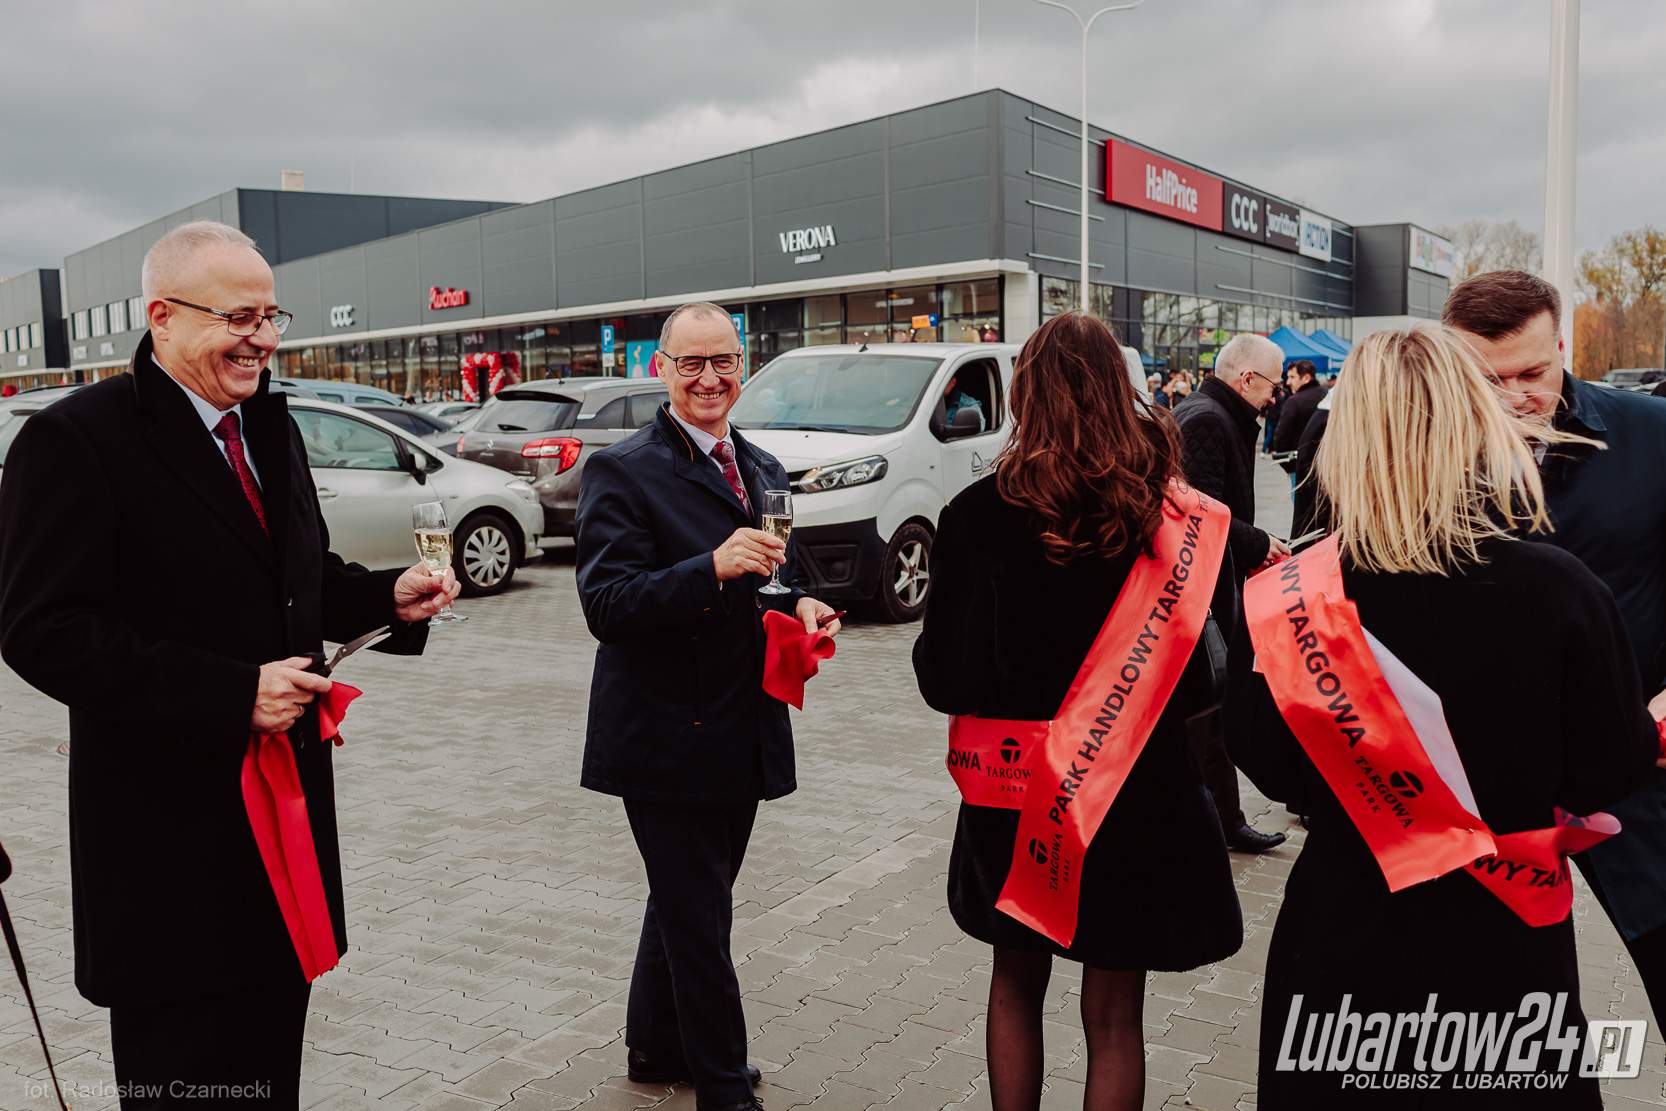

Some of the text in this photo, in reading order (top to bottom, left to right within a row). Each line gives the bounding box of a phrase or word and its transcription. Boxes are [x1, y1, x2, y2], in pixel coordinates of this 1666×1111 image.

[1145, 163, 1198, 214] HalfPrice
[1231, 192, 1258, 234] CCC
[779, 224, 836, 253] VERONA
[330, 304, 353, 328] CCC
[428, 286, 469, 311] Auchan
[1048, 514, 1203, 827] PARK HANDLOWY TARGOWA
[1285, 596, 1367, 750] TARGOWA
[1353, 755, 1415, 831] TARGOWA
[1355, 781, 1382, 814] PARK
[1048, 832, 1064, 893] TARGOWA
